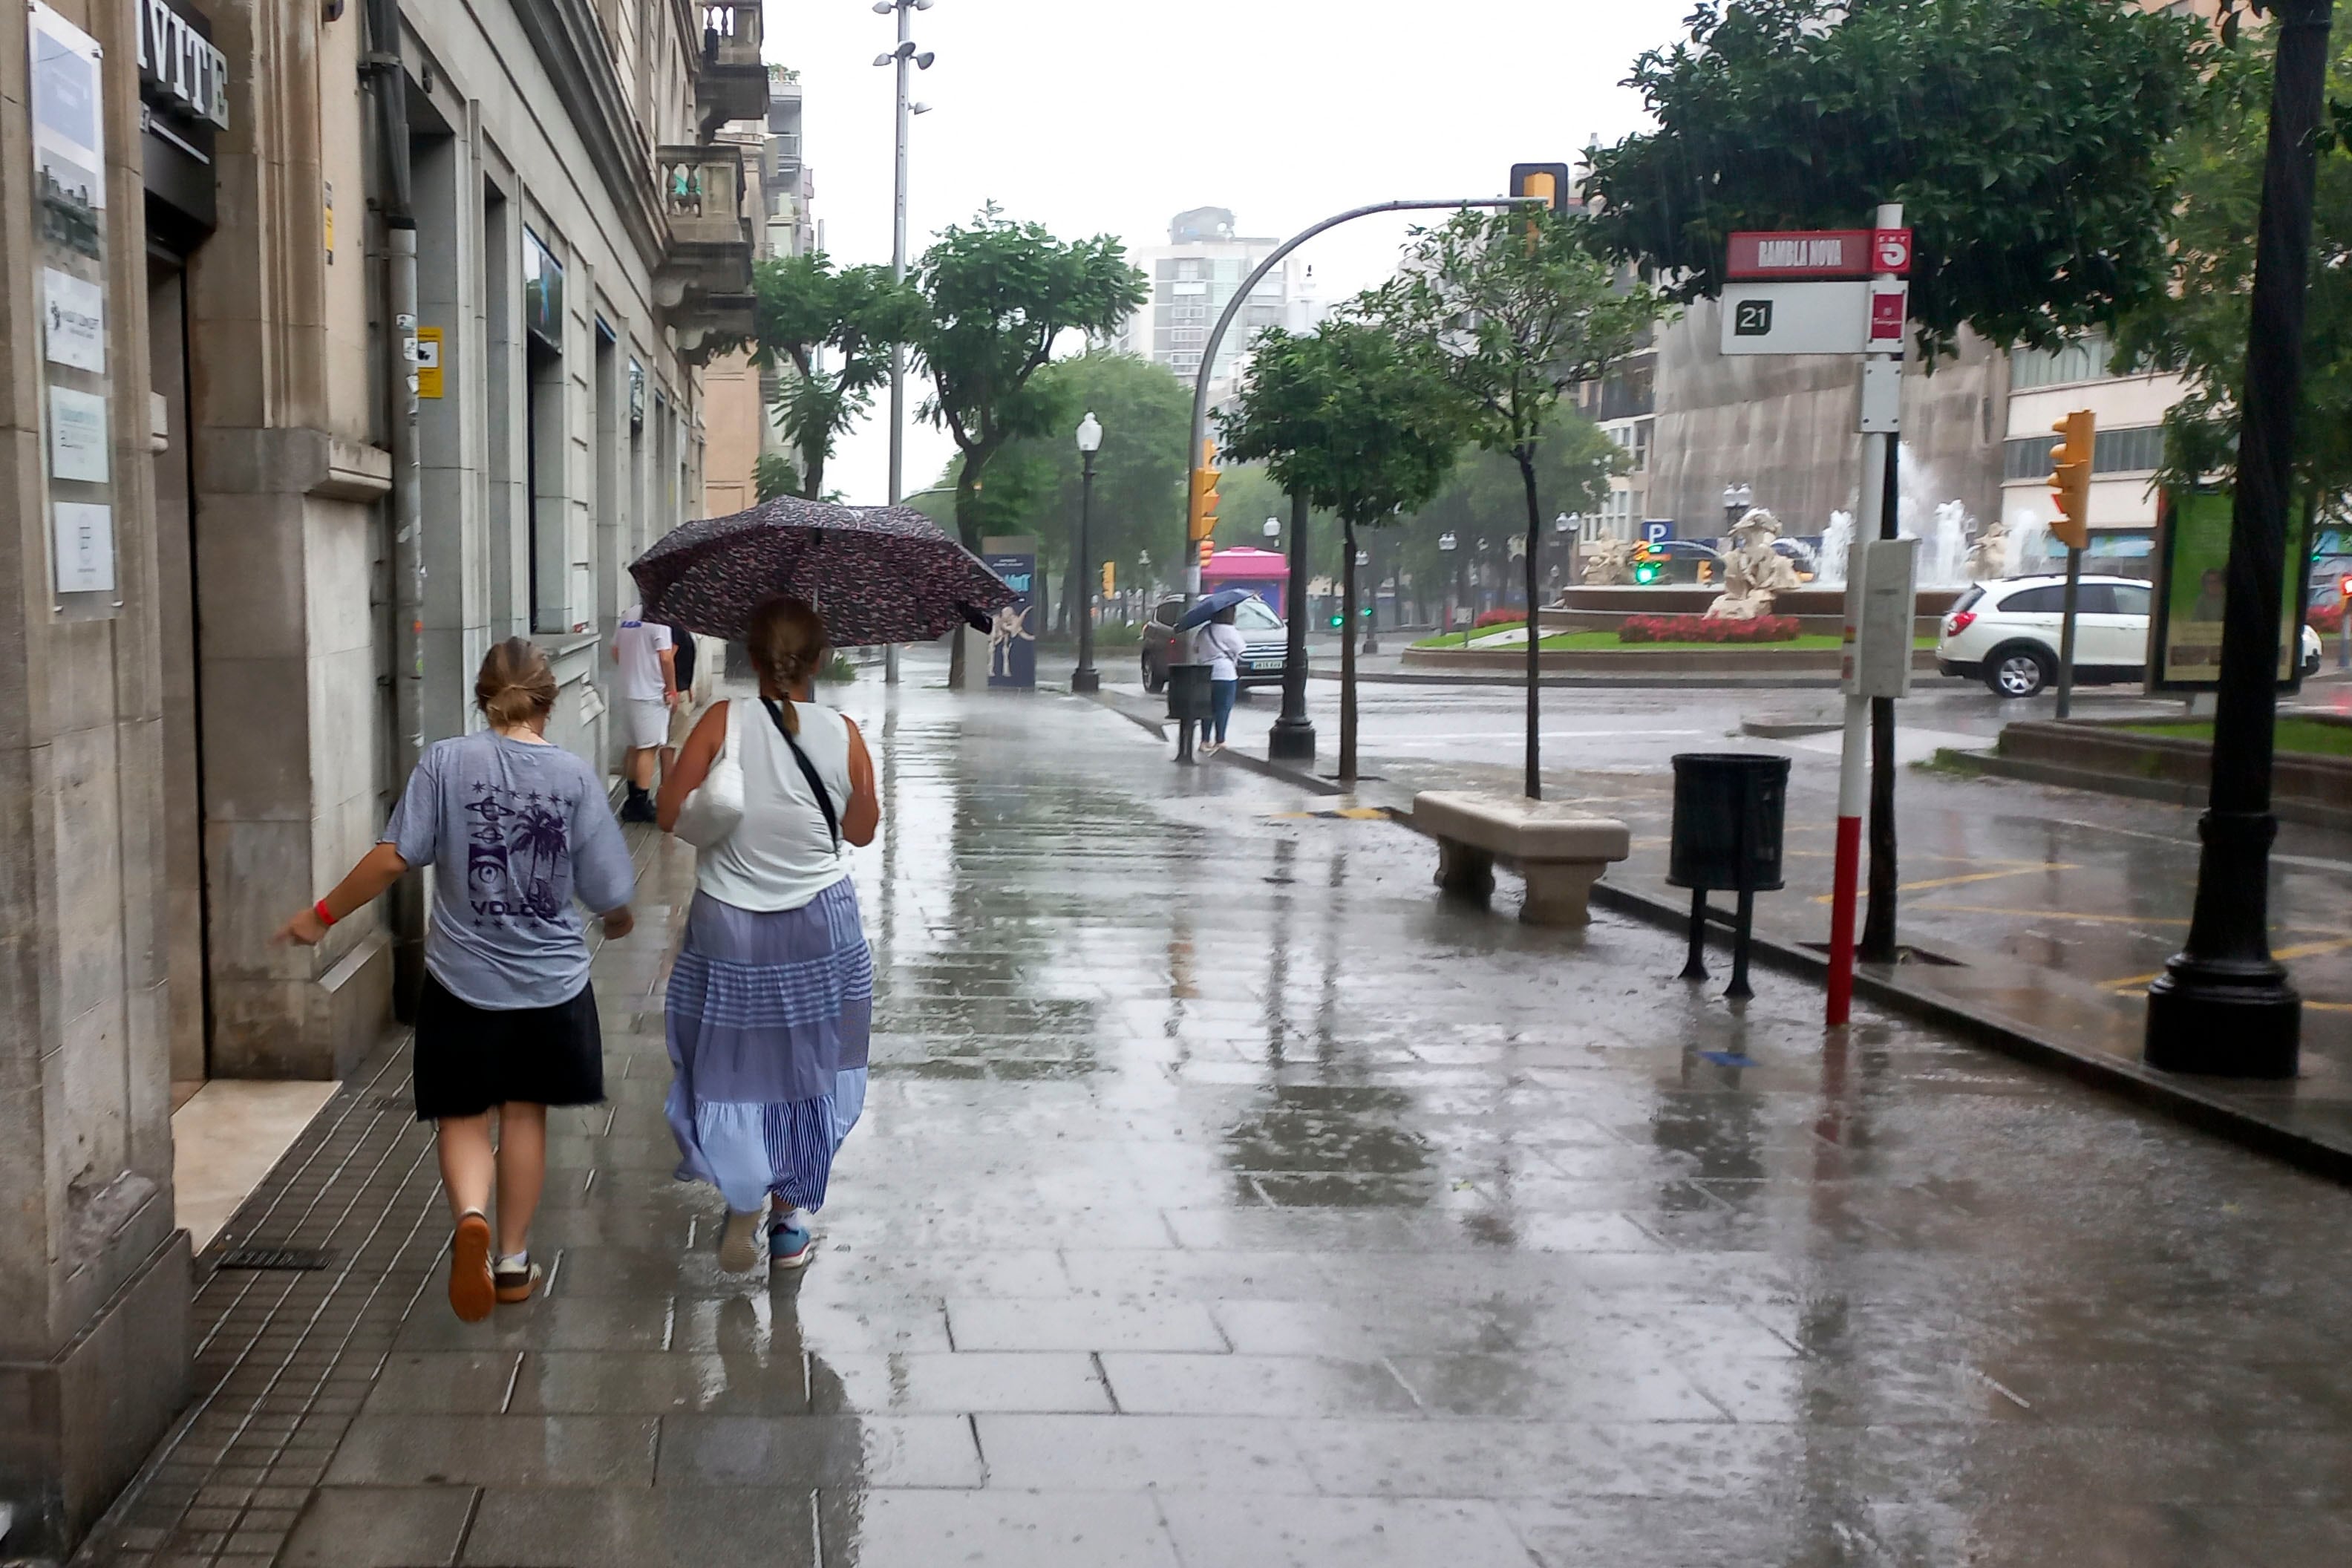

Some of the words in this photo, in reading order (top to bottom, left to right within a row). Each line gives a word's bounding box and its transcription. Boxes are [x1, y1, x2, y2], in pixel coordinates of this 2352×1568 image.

[1758, 240, 1808, 267] RAMBLA
[1809, 239, 1842, 267] NOVA
[1740, 307, 1765, 327] 21
[1649, 523, 1667, 543] P
